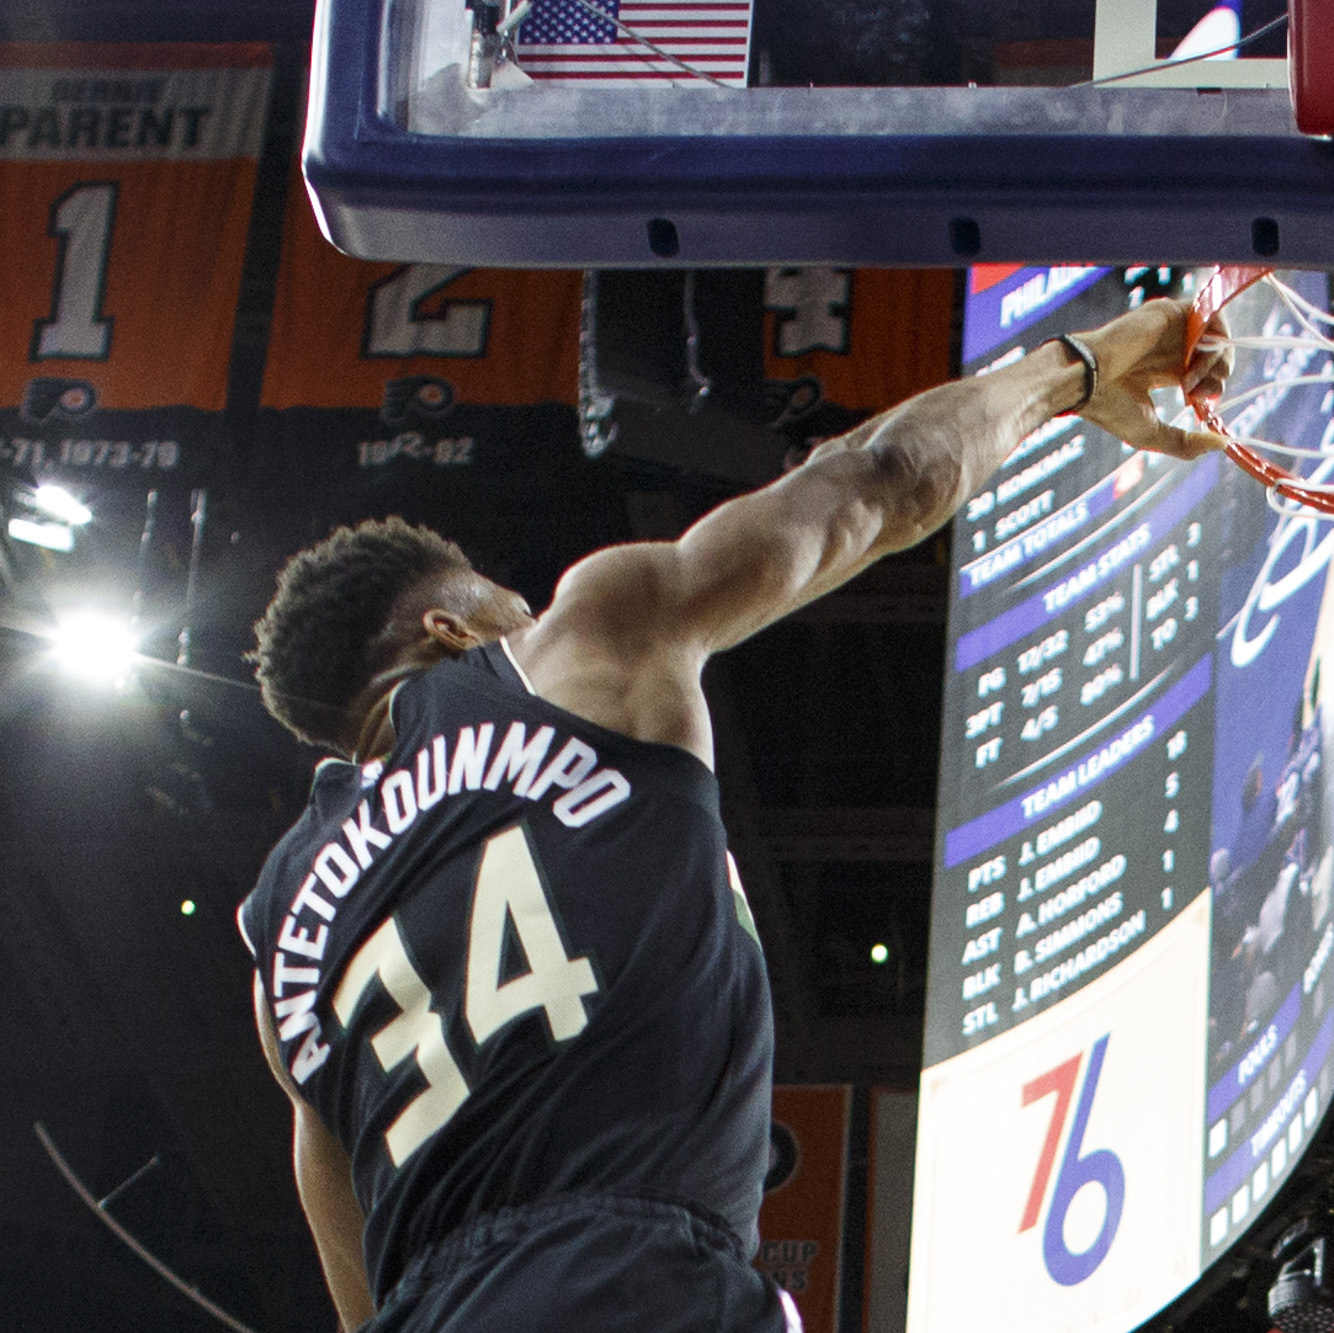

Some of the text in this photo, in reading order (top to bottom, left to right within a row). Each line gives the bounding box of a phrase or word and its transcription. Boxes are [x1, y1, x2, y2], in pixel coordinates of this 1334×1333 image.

[0, 107, 210, 149] PARENT
[29, 180, 119, 362] 1
[967, 491, 995, 521] 30
[996, 435, 1085, 504] KORKMAZ
[967, 502, 1090, 588] TEAM TOTALS
[972, 490, 1055, 552] 1 SCOTT
[977, 666, 1006, 697] FG
[1148, 544, 1180, 582] STL
[1186, 522, 1201, 548] 3
[1043, 523, 1152, 613] TEAM STATS
[965, 701, 1005, 739] 3PT
[1146, 578, 1179, 620] BLK
[1186, 559, 1200, 582] 1
[975, 737, 1003, 768] FT
[1021, 705, 1060, 741] 4/5
[1151, 618, 1178, 650] TO
[1184, 596, 1199, 621] 3
[1022, 719, 1154, 819] TEAM LEADERS
[274, 721, 631, 1084] ANTETOKOUNMPO
[962, 927, 1001, 965] AST
[1038, 854, 1127, 925] HORFORD
[1164, 809, 1180, 833] 4
[965, 892, 1004, 929] REB
[1034, 837, 1101, 891] EMBIID
[1165, 772, 1180, 798] 5
[968, 855, 1007, 893] PTS
[1036, 800, 1102, 856] EMBIID
[332, 825, 599, 1167] 34
[962, 963, 1000, 1001] BLK
[1034, 891, 1123, 962] SIMMONS
[1162, 850, 1174, 872] 1
[962, 1001, 998, 1036] STL
[1030, 910, 1146, 992] RICHARDSON
[1161, 887, 1174, 910] 1
[1018, 1031, 1125, 1286] 76
